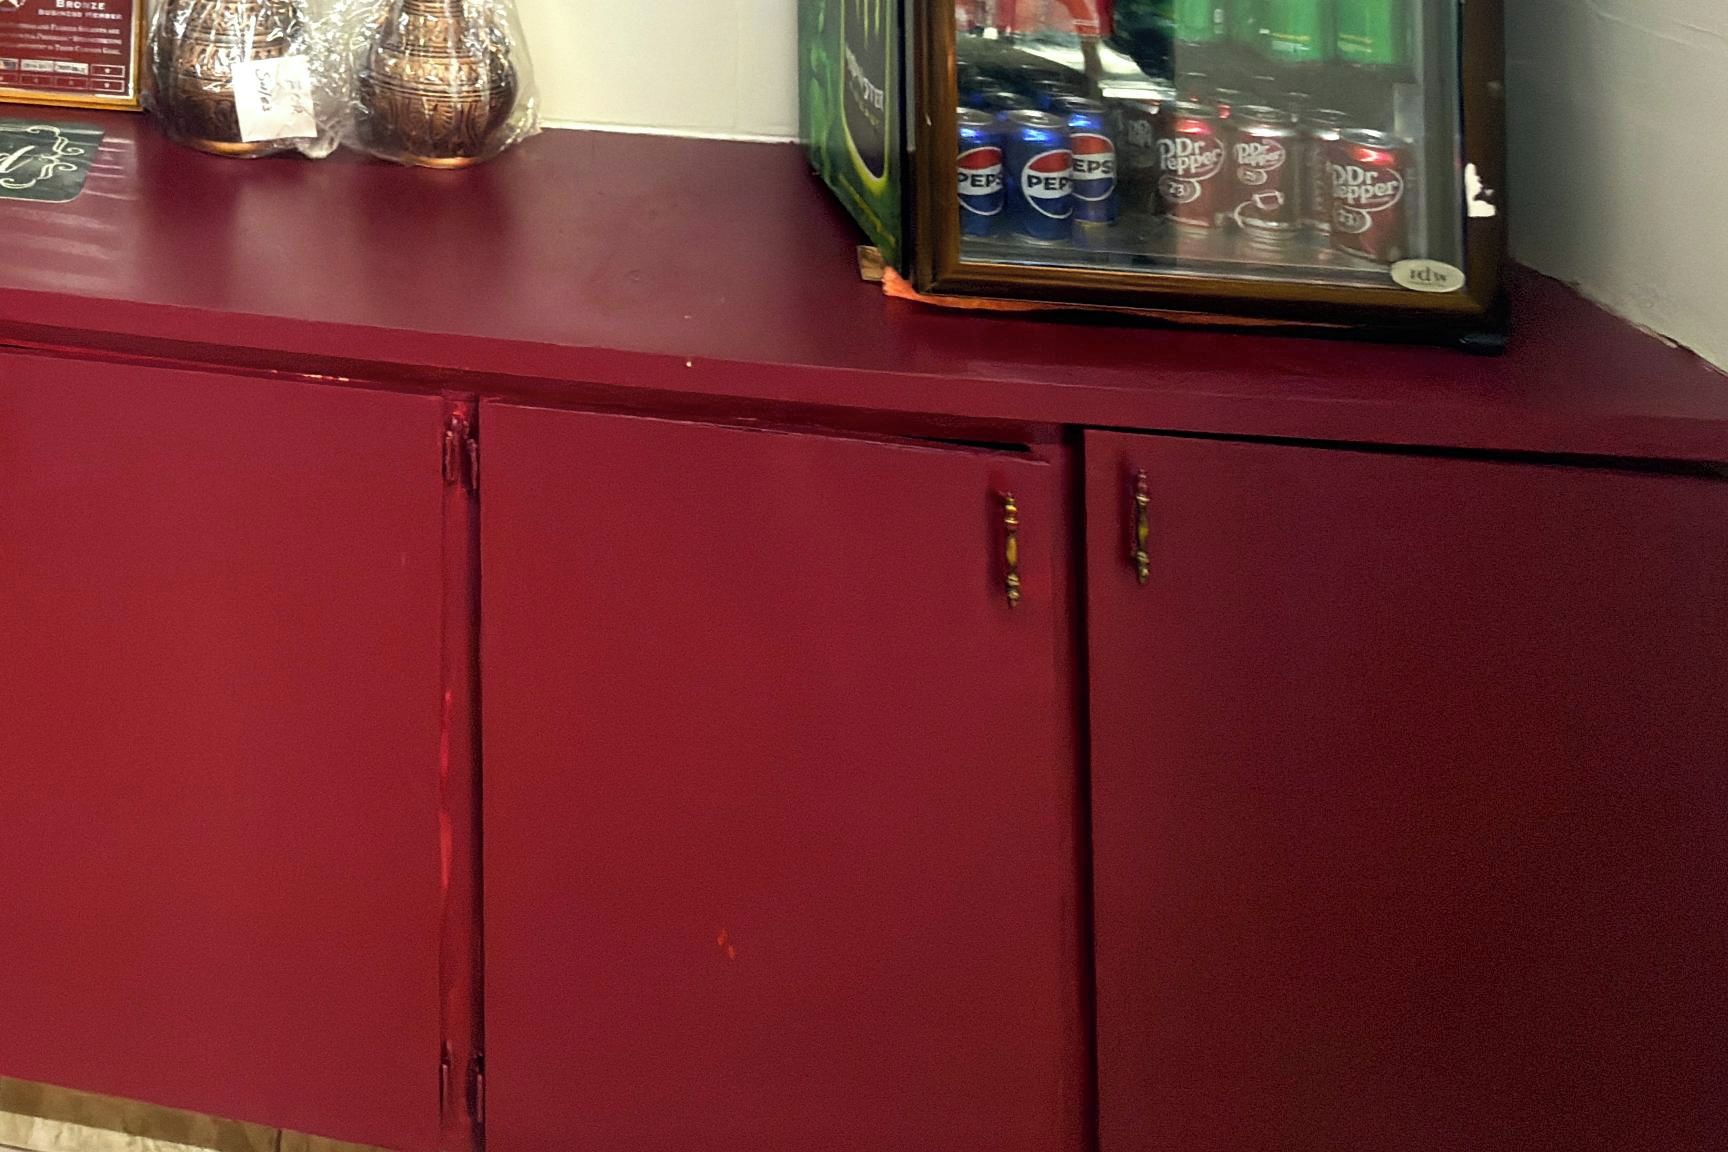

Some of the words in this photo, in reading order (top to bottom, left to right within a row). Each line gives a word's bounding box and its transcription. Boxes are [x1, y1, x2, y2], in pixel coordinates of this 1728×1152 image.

[55, 0, 106, 11] BRONZE
[1176, 137, 1206, 155] Dr
[1073, 158, 1114, 174] EPS
[1347, 165, 1378, 185] Dr
